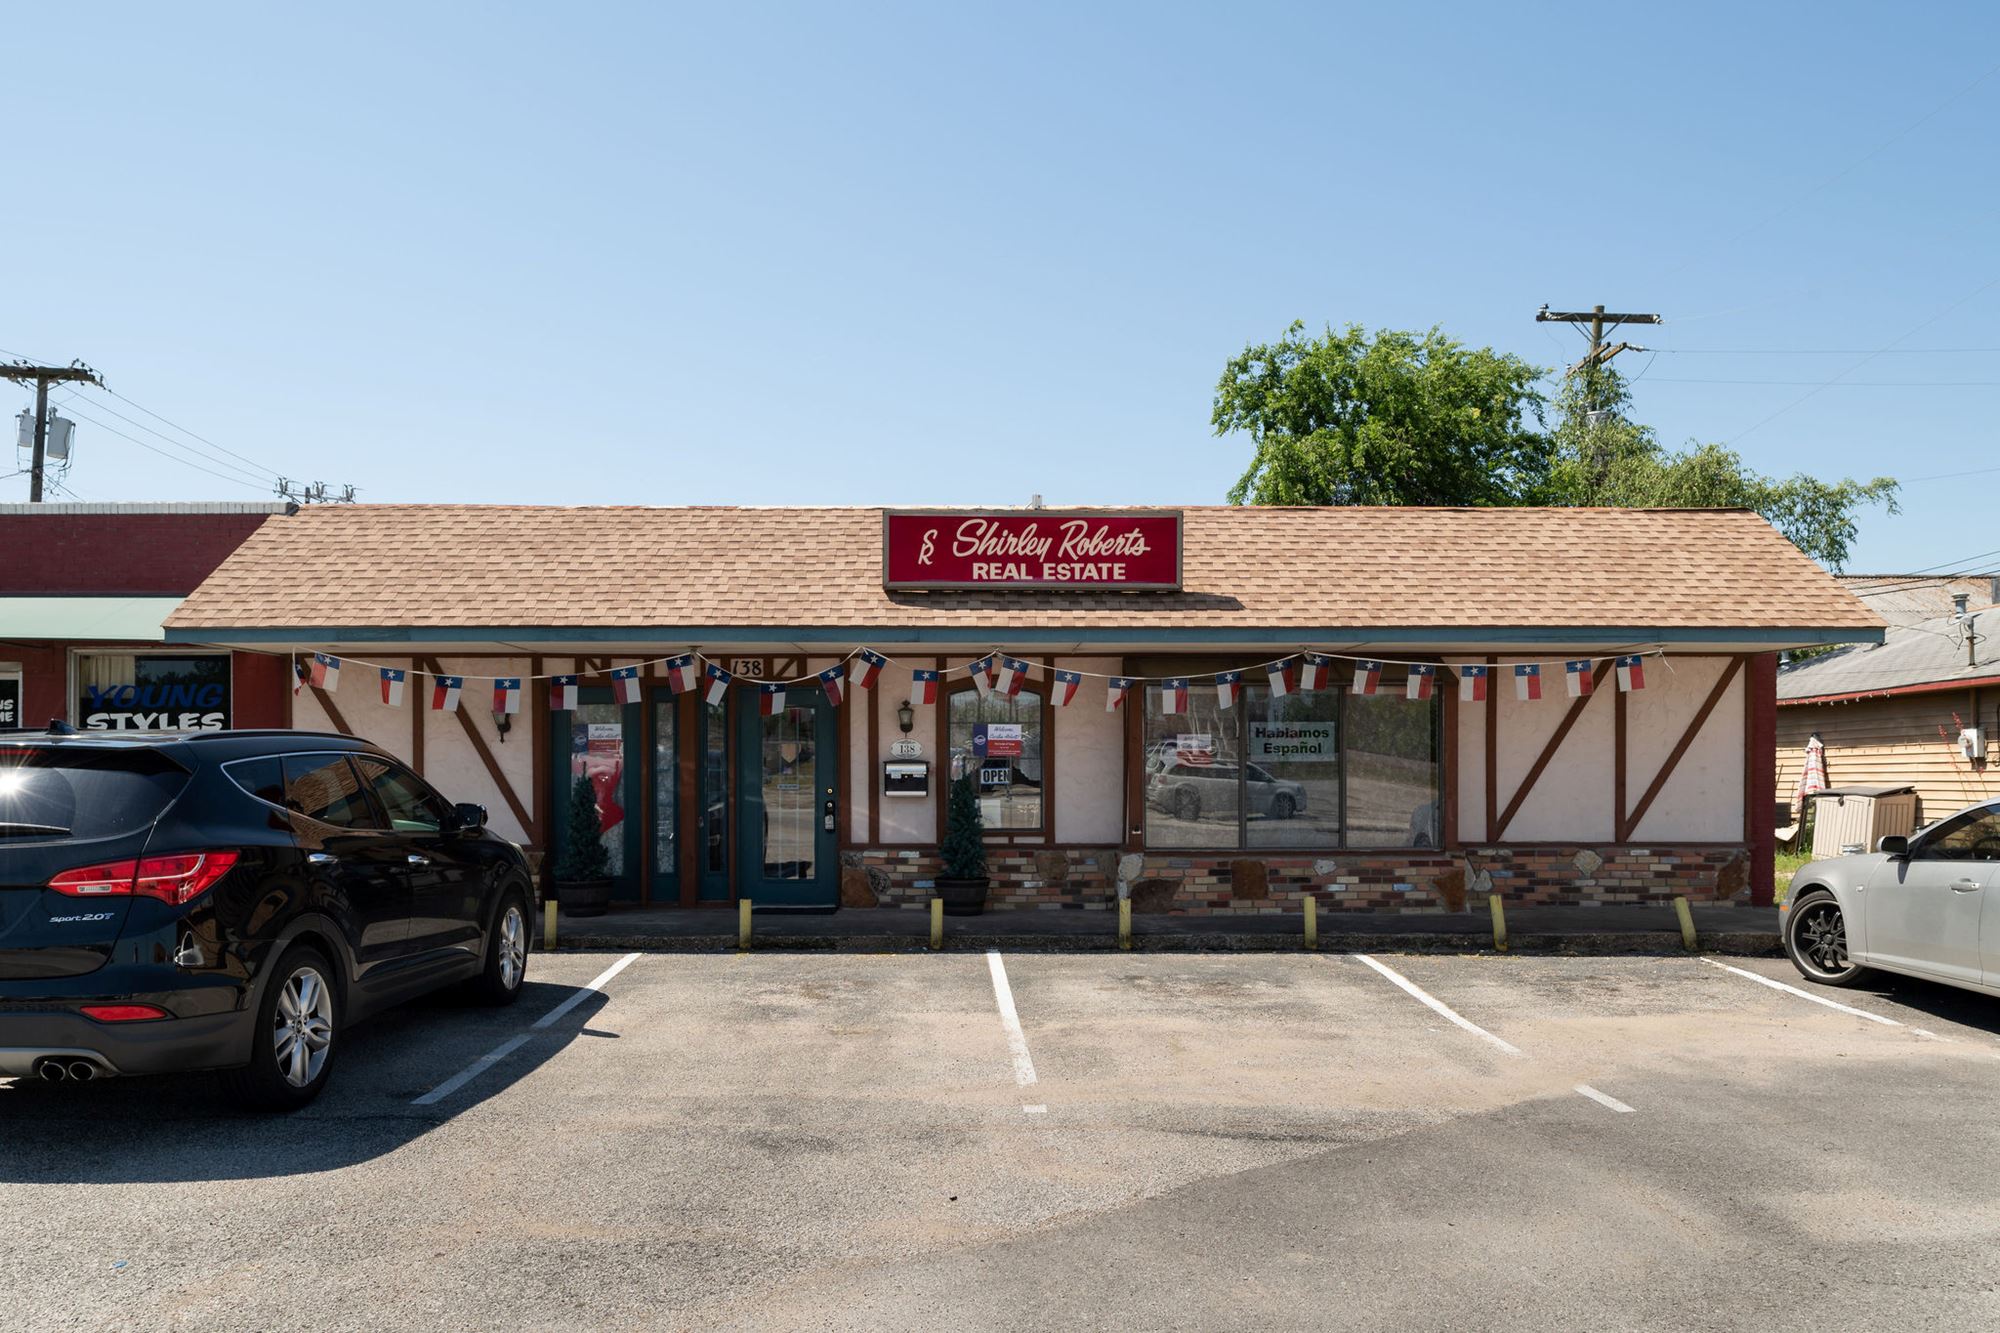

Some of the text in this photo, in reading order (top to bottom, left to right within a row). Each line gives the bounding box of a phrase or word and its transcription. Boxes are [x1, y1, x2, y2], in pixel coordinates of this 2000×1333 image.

[952, 518, 1151, 562] Shirley Roberts
[972, 562, 1126, 580] REAL ESTATE
[733, 660, 762, 676] 138
[88, 682, 225, 709] YOUNG
[86, 712, 225, 730] STYLES
[1255, 727, 1329, 739] Hablamos
[900, 744, 916, 754] 138
[1263, 741, 1322, 756] Español
